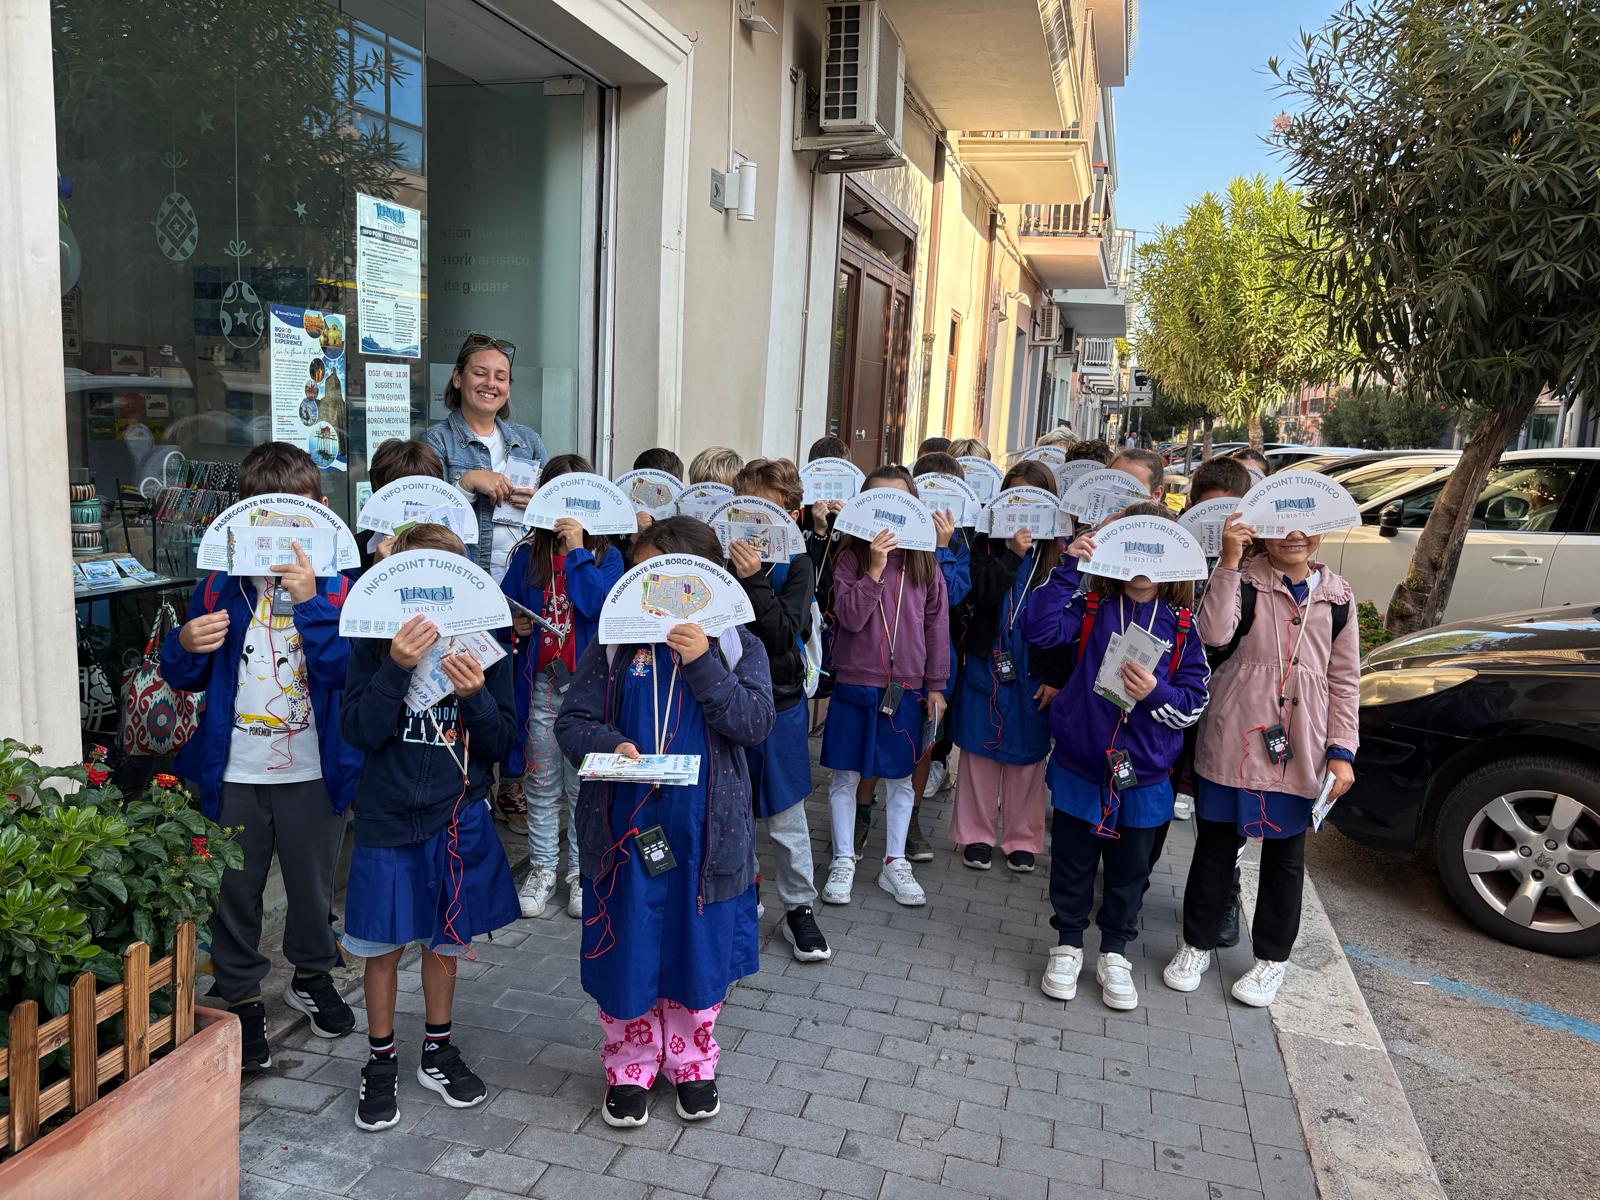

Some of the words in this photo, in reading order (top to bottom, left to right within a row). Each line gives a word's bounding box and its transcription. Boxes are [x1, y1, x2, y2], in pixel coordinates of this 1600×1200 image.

[373, 230, 384, 238] POINT
[462, 280, 509, 294] guidate
[381, 488, 401, 502] INFO
[402, 483, 430, 492] POINT
[431, 484, 463, 508] TURISTIC
[542, 484, 560, 500] INFO
[560, 478, 586, 488] POINT
[586, 479, 623, 506] TURISTICO
[666, 475, 684, 491] MEDIEVA
[711, 484, 729, 493] BORGO
[1078, 478, 1094, 491] INFO
[1117, 476, 1140, 492] TURIST
[1248, 489, 1266, 507] INFO
[1266, 476, 1293, 493] POINT
[1295, 476, 1340, 499] TURISTICO
[855, 496, 871, 509] INFO
[897, 495, 927, 524] TURISTICO
[1025, 488, 1043, 496] BORGO
[1043, 492, 1060, 507] MEDIEV
[214, 499, 259, 532] PASSEGGIATE
[260, 497, 275, 505] NEL
[277, 497, 306, 507] BORGO
[305, 503, 342, 532] MEDIEVALE
[708, 501, 732, 523] ASSEGGIATE
[743, 498, 764, 506] BORGO
[764, 502, 791, 525] MEDIEVALE
[1188, 508, 1207, 523] INFO
[1207, 503, 1233, 513] POINT
[1277, 511, 1316, 520] TURISTICA
[1099, 528, 1118, 544] INFO
[1120, 521, 1147, 533] POINT
[1149, 522, 1190, 549] TURISTICO
[1205, 523, 1215, 555] Termoli
[363, 572, 389, 596] INFO
[389, 558, 426, 576] POINT
[428, 558, 485, 590] TURISTICO
[611, 565, 649, 604] PASSEGGIATE
[649, 560, 665, 570] NEL
[665, 558, 693, 566] BORGO
[694, 561, 733, 587] MEDIEVALE
[401, 605, 453, 614] TURISTICA
